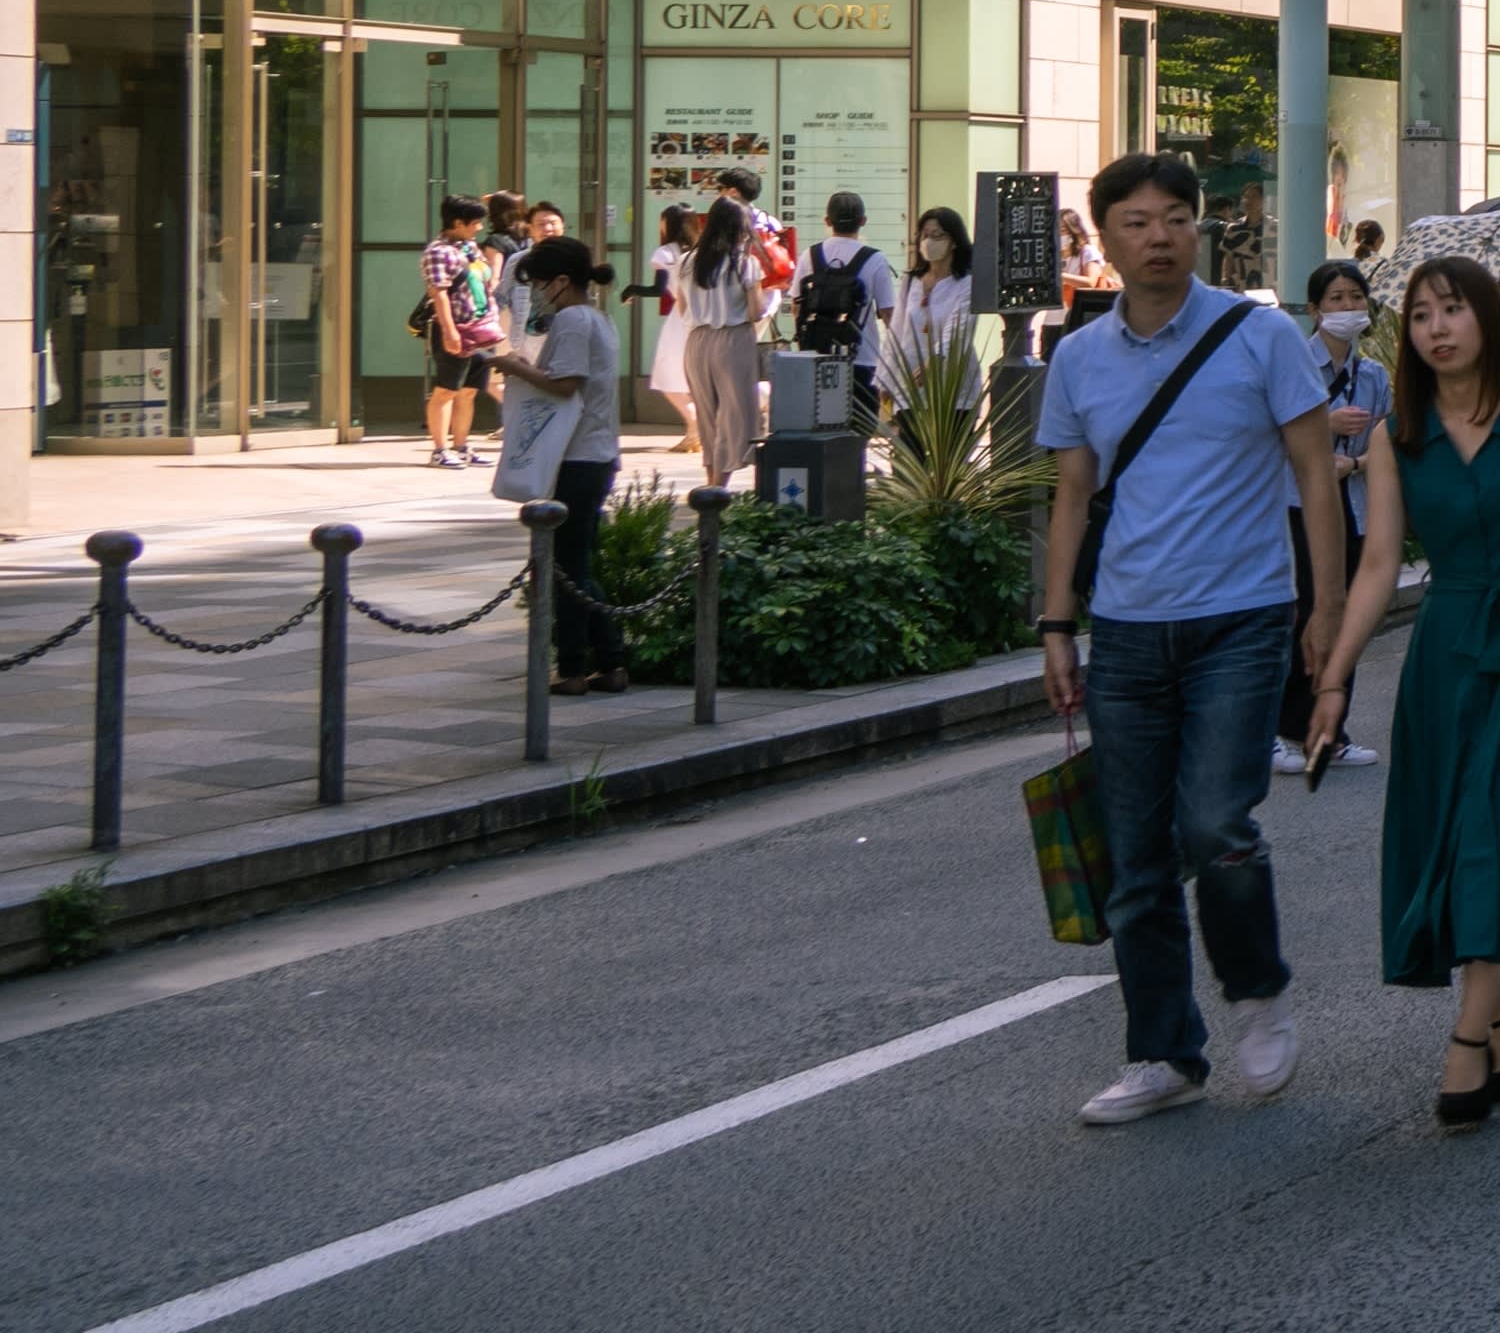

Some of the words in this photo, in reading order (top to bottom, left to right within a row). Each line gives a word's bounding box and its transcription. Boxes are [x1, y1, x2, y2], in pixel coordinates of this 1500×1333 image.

[662, 2, 776, 31] GINZA
[792, 2, 893, 31] CORE
[664, 107, 722, 116] RESTAURANT
[725, 107, 755, 116] GUIDE
[846, 112, 876, 120] GUIDE
[1012, 238, 1045, 264] 5丁目
